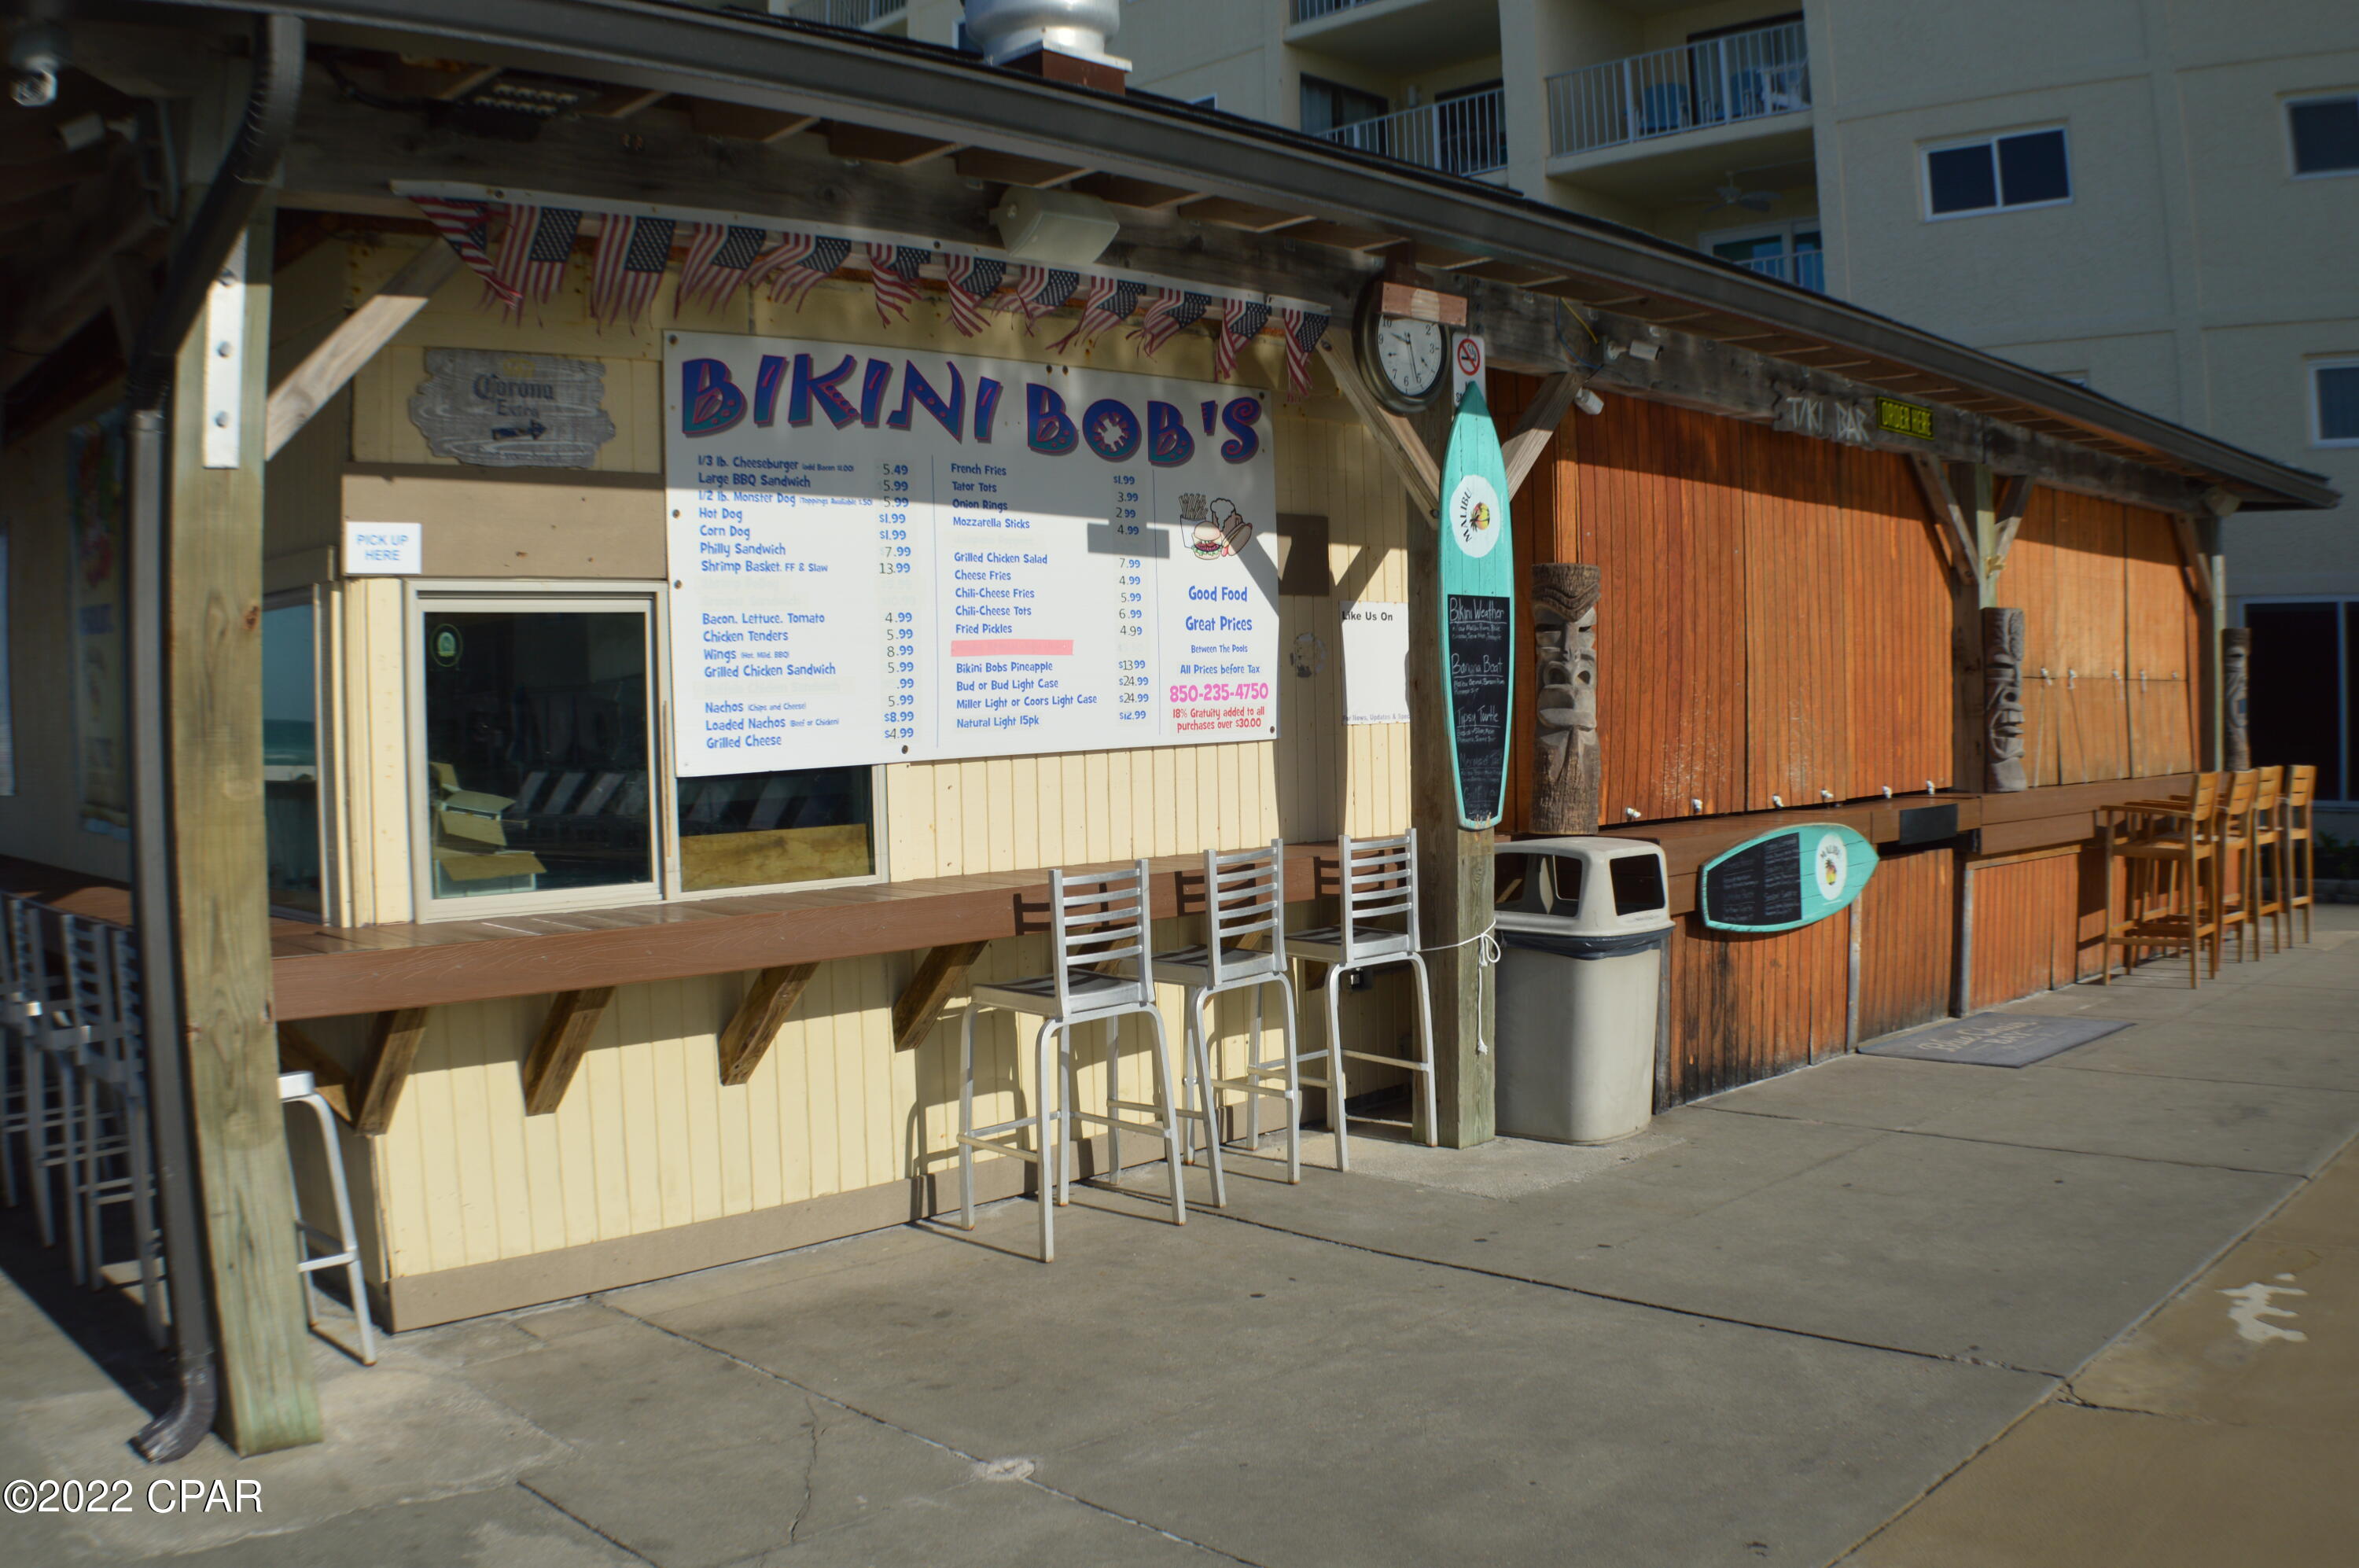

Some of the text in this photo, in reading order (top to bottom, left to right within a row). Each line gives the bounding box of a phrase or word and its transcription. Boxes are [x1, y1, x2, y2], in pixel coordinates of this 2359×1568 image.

[1378, 333, 1384, 344] 9
[1426, 325, 1431, 336] 2
[1430, 343, 1434, 354] 3
[1393, 368, 1397, 380] 7
[1404, 376, 1409, 387] 6
[472, 373, 556, 400] Corona
[495, 399, 540, 418] Extra
[682, 353, 1261, 468] BIKINI BOB'S
[1786, 396, 1823, 432] TIKI
[716, 455, 728, 466] lb.
[733, 456, 799, 473] Cheeseburger
[883, 463, 908, 475] 5.49
[698, 472, 908, 492] Large BBQ Sandwich 5.99
[951, 463, 1135, 485] French Fries $1.99
[717, 490, 729, 502] lb.
[734, 491, 773, 503] Monster
[777, 492, 796, 507] Dog
[884, 496, 909, 508] 5.99
[951, 481, 1139, 502] Tator Tots 3.99
[952, 499, 979, 509] Onion
[982, 499, 1008, 513] Rings
[699, 507, 906, 524] Hot Dog $1.99
[700, 525, 906, 540] Corn Dog $1.99
[953, 517, 1139, 536] Mozzarella Sticks 4.99
[357, 534, 409, 546] PICK UP
[365, 549, 401, 561] HERE
[701, 542, 911, 558] Philly Sandwich 7.99
[701, 560, 742, 574] Shrimp
[785, 562, 795, 572] FF
[798, 562, 804, 572] &
[808, 562, 828, 572] Slaw
[878, 562, 911, 574] 13.99
[954, 552, 1140, 569] Grilled Chicken Salad 7.99
[955, 569, 1140, 585] Cheese Fries 4.99
[955, 587, 1141, 602] Chili-Cheese Fries 5.99
[1188, 585, 1248, 602] Good Food
[955, 605, 1142, 619] Chili-Cheese Tots 6.99
[1341, 611, 1393, 621] Like Us On
[1449, 597, 1504, 621] Bikini Weather
[787, 613, 825, 624] Tomato
[885, 612, 912, 624] 4.99
[1185, 616, 1253, 631] Great Prices
[703, 629, 913, 642] Chicken Tenders 5.99
[955, 623, 1143, 636] Fried Pickles 4.99
[704, 648, 737, 663] Wings
[887, 646, 914, 657] 8.99
[1191, 644, 1248, 653] Between The Pools
[704, 662, 914, 678] Grilled Chicken Sandwich 5.99
[956, 662, 982, 673] Bikini
[985, 662, 1007, 672] Bobs
[1010, 661, 1053, 674] Pineapple
[1180, 664, 1260, 675] All Prices before Tax
[1451, 653, 1503, 674] Banana Boat
[956, 675, 1149, 693] Bud or Bud Light Case $24.99
[1169, 682, 1269, 703] 850-235-4750
[705, 701, 743, 713] Nachos
[888, 695, 914, 707] 5.99
[956, 693, 1149, 711] Miller Light or Coors Light Case $24.99
[1172, 706, 1265, 720] 18% Gratuity added to all
[1456, 705, 1500, 727] Tipsy Turtle
[706, 718, 744, 731] Loaded
[748, 716, 786, 730] Nachos
[884, 712, 914, 723] $8.99
[956, 716, 991, 728] Natural
[994, 716, 1016, 730] Light
[1020, 715, 1040, 726] 15pk
[1177, 718, 1261, 733] purchases over $30.00
[706, 727, 914, 749] Grilled Cheese $4.99
